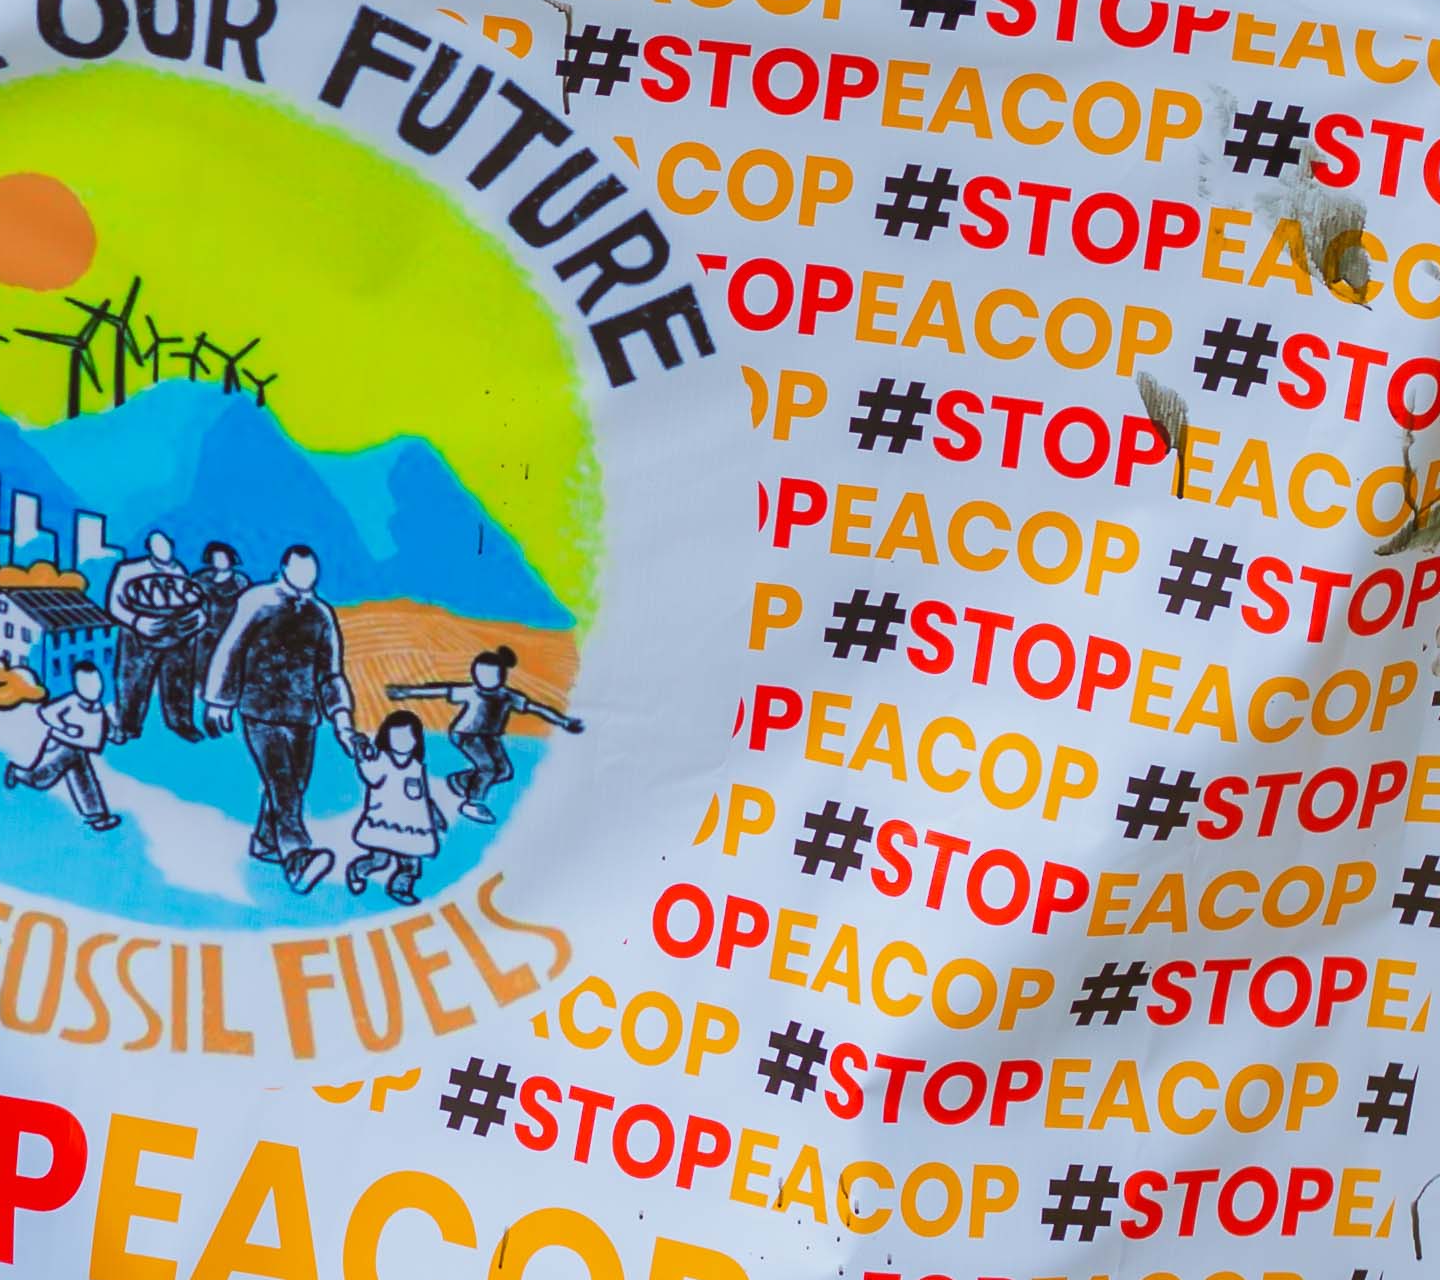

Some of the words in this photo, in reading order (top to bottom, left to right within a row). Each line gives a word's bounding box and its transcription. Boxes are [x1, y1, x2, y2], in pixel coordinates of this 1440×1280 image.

[556, 25, 1202, 161] #STOPEACOP
[318, 4, 716, 389] FUTURE
[758, 477, 1140, 596] PEACOP
[825, 589, 1418, 744] #STOPEACOP
[734, 685, 1098, 821] PEACOP
[795, 801, 1377, 937] #STOPEACOP
[272, 871, 573, 1061] FUELS
[653, 883, 1055, 1030] OPEACOP
[530, 976, 740, 1076] COP
[758, 1021, 1339, 1135] #STOPEACOP
[440, 1056, 1020, 1239] #STOPEACOP
